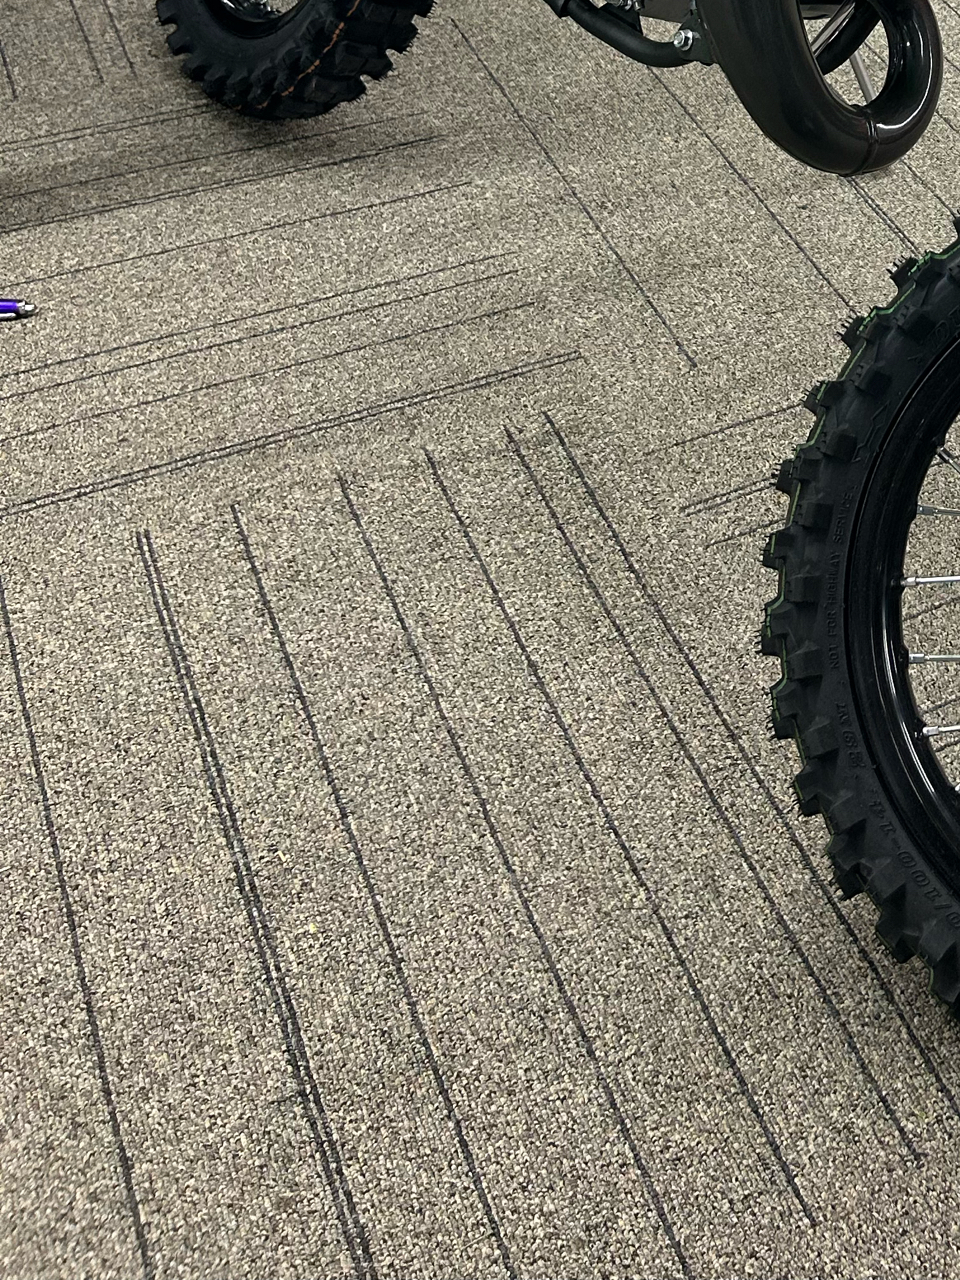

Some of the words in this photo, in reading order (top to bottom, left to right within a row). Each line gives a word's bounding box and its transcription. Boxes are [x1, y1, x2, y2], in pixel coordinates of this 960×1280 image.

[823, 550, 841, 607] HIGHWAY
[825, 609, 838, 638] FOR
[828, 643, 841, 669] NOT
